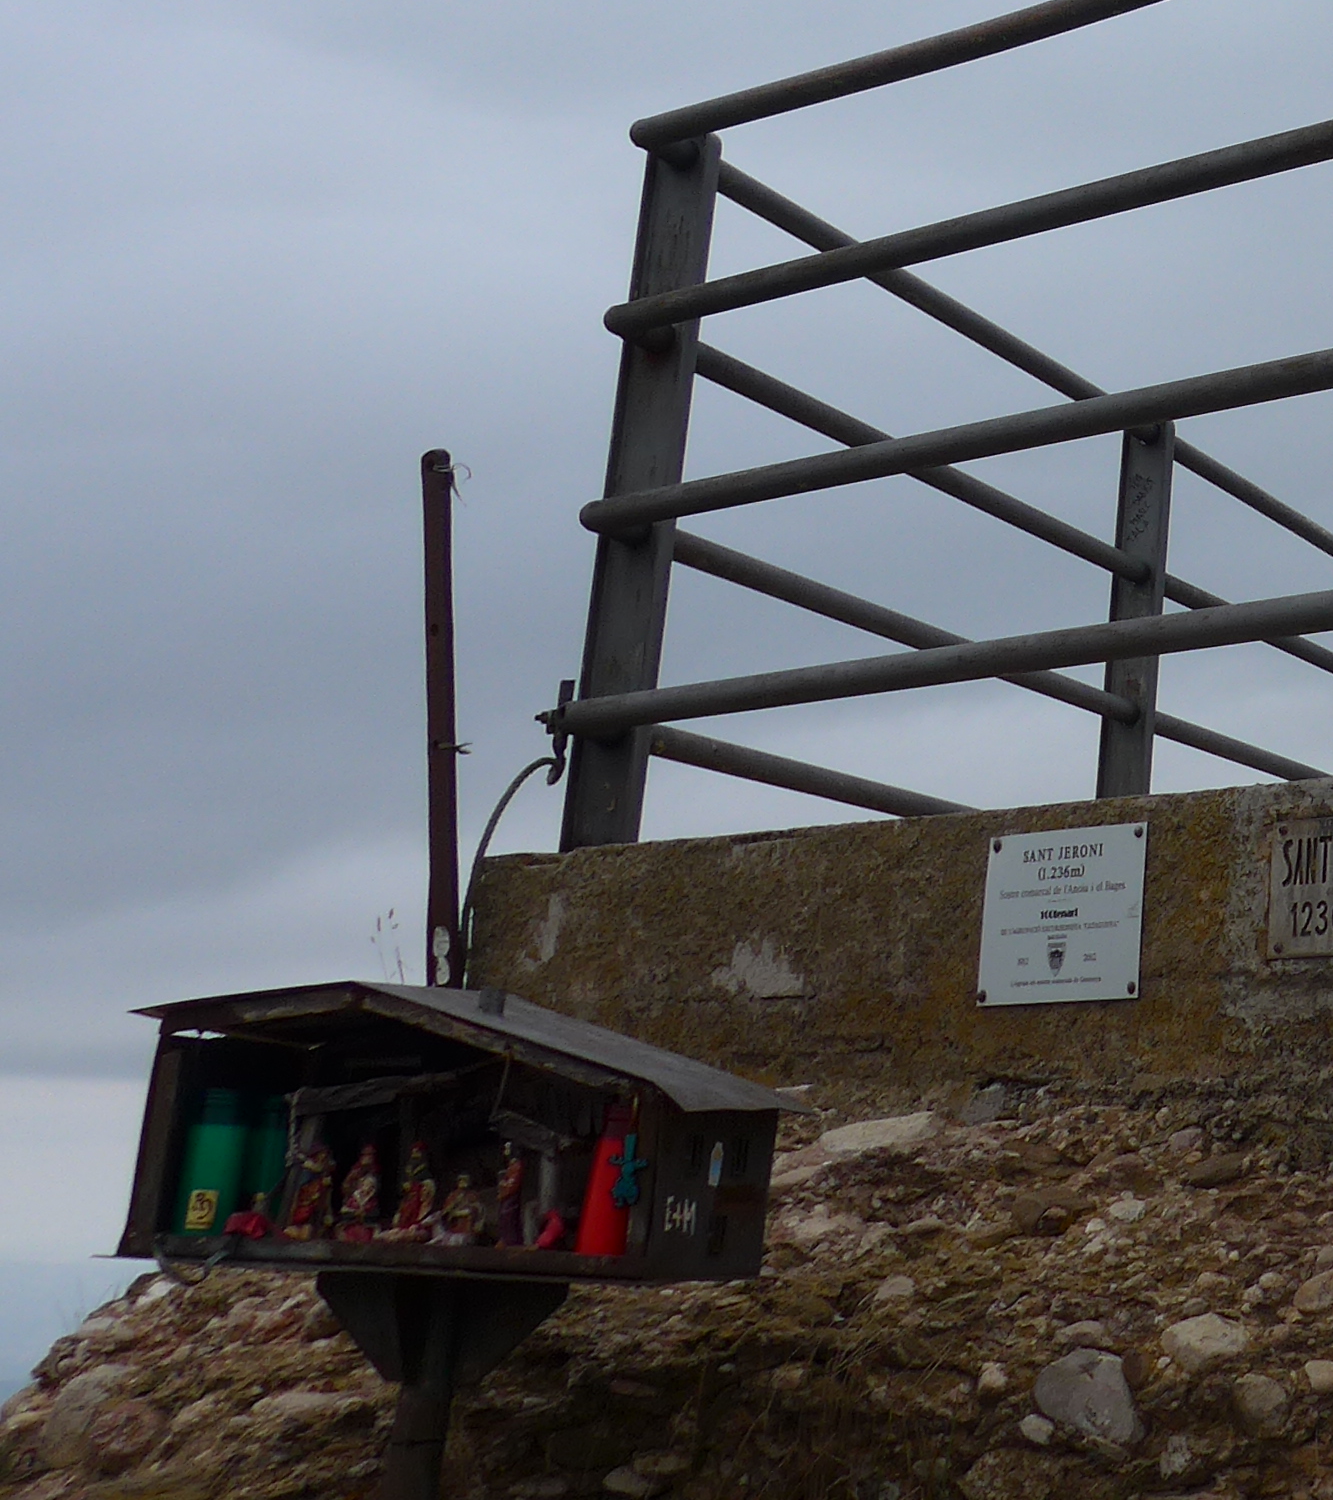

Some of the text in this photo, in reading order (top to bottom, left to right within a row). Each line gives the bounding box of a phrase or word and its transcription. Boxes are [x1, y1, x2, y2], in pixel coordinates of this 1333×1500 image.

[1023, 843, 1104, 863] SANT JERONI
[1282, 835, 1332, 887] SANT
